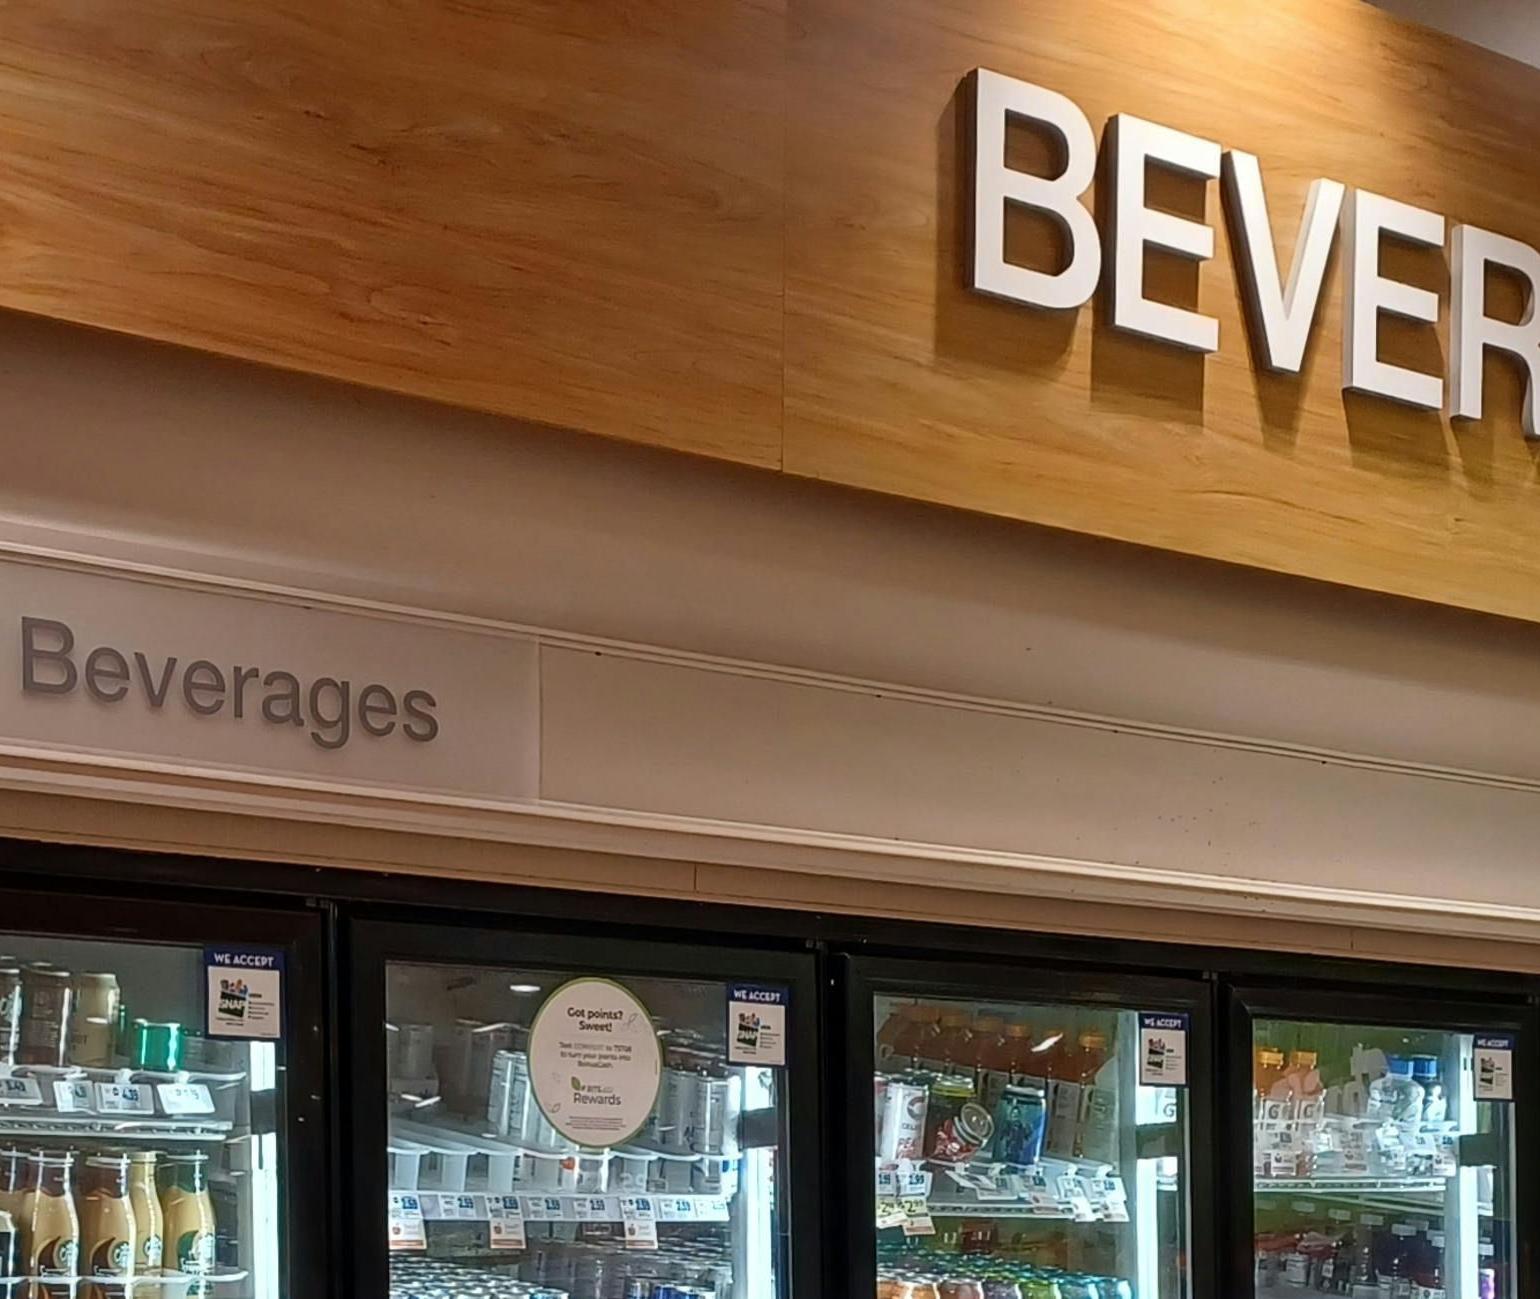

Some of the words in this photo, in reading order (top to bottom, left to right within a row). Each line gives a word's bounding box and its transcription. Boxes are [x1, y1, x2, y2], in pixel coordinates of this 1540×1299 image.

[21, 616, 439, 750] Beverages
[214, 952, 230, 965] WE
[233, 955, 275, 967] ACCEPT
[733, 988, 746, 1000] WE
[747, 990, 781, 1003] ACCEPT
[220, 999, 246, 1010] SNAP
[567, 1007, 585, 1018] Got
[587, 1008, 623, 1020] points?
[579, 1021, 612, 1032] Sweet!
[573, 1093, 621, 1105] Rewards
